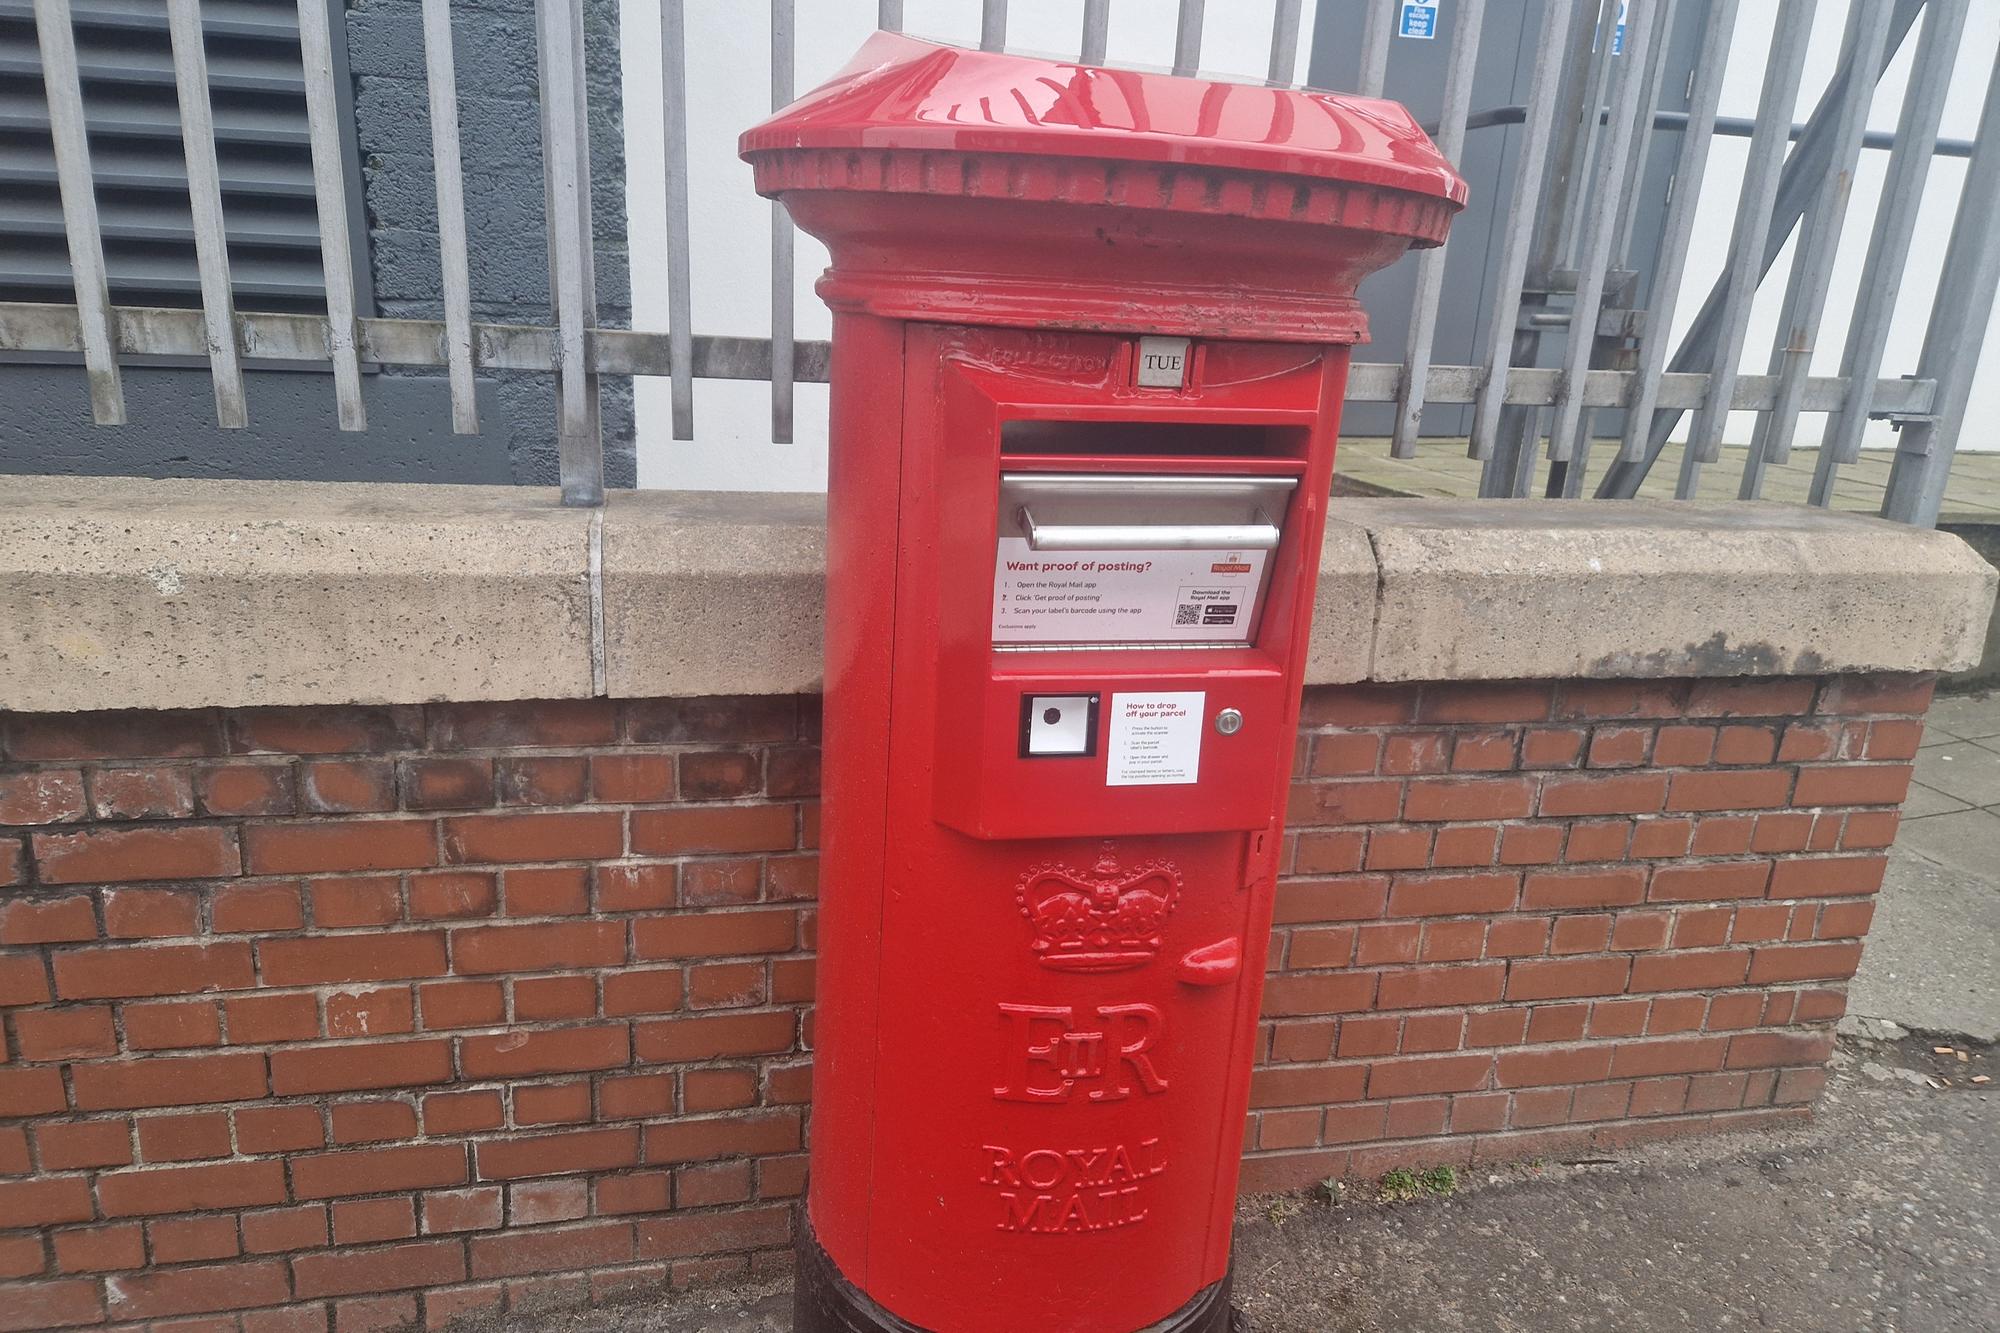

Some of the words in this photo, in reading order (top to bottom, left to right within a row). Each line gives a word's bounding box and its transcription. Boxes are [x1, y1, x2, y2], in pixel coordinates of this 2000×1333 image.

[1408, 12, 1430, 20] escape
[1408, 19, 1428, 28] keep
[1407, 27, 1427, 35] clear
[1144, 355, 1182, 371] TUE
[1006, 561, 1039, 571] Want
[1042, 561, 1078, 573] proof
[1081, 561, 1096, 571] of
[1097, 561, 1152, 573] posting?
[1047, 594, 1066, 602] proof
[1098, 607, 1116, 615] using
[1157, 702, 1177, 710] drop
[1160, 710, 1187, 718] parcel
[979, 1137, 1168, 1188] ROYAL
[996, 1185, 1149, 1233] MAIL
